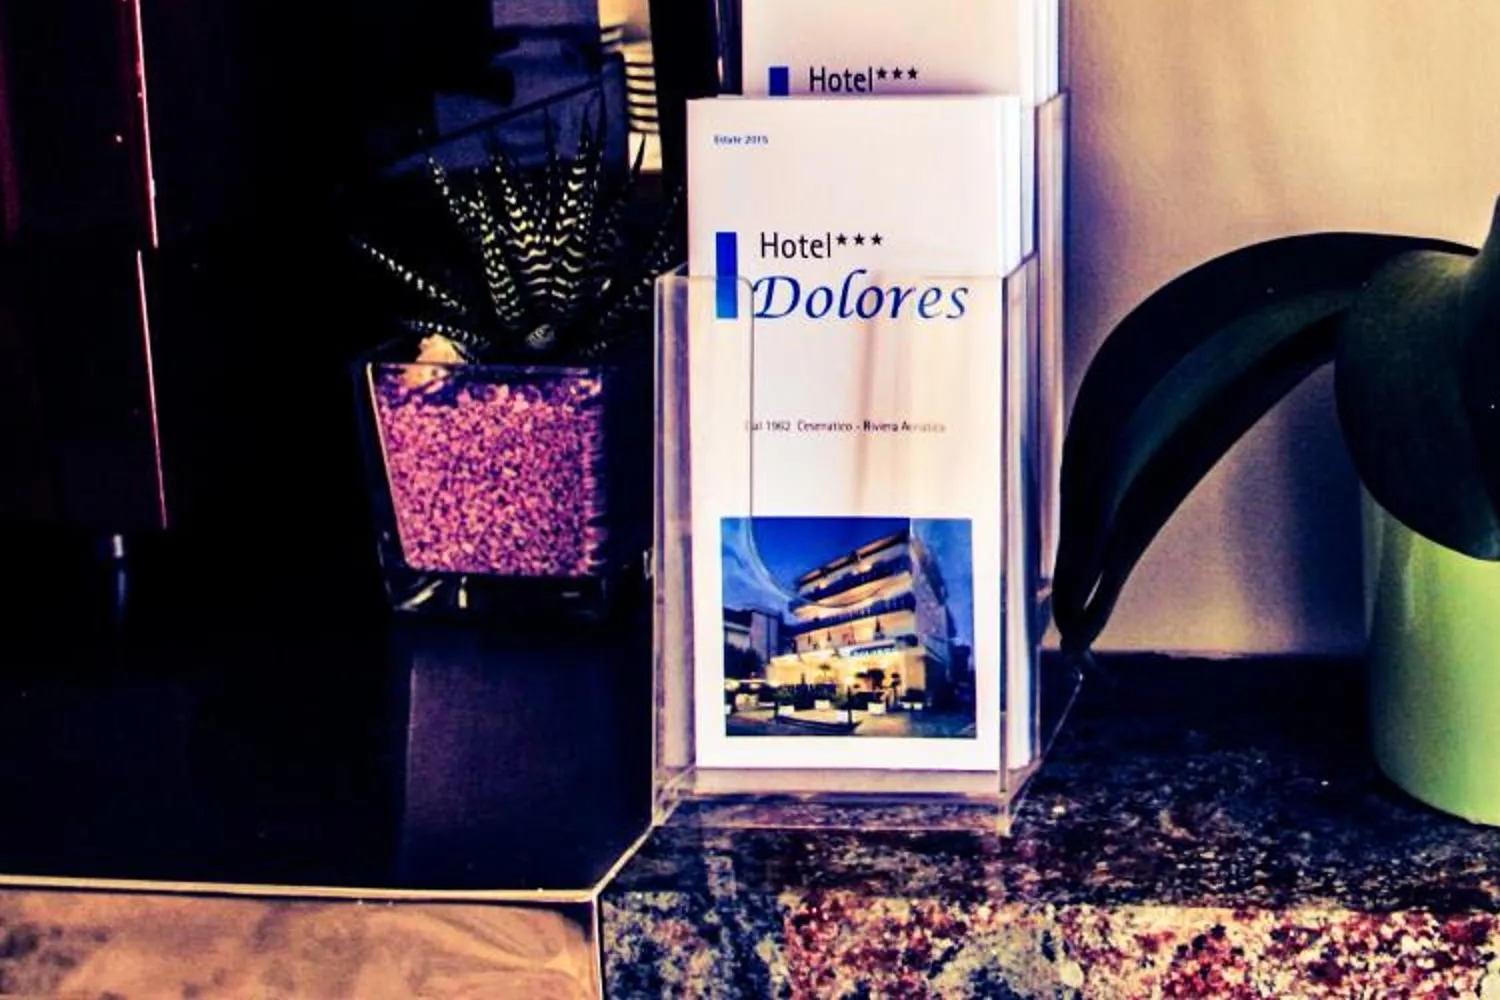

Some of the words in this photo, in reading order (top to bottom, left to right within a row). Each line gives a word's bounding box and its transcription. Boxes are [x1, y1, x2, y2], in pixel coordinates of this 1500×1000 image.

[808, 66, 874, 93] Hotel
[760, 231, 832, 258] Hotel
[751, 269, 969, 319] Dolores
[863, 420, 898, 433] Riviera
